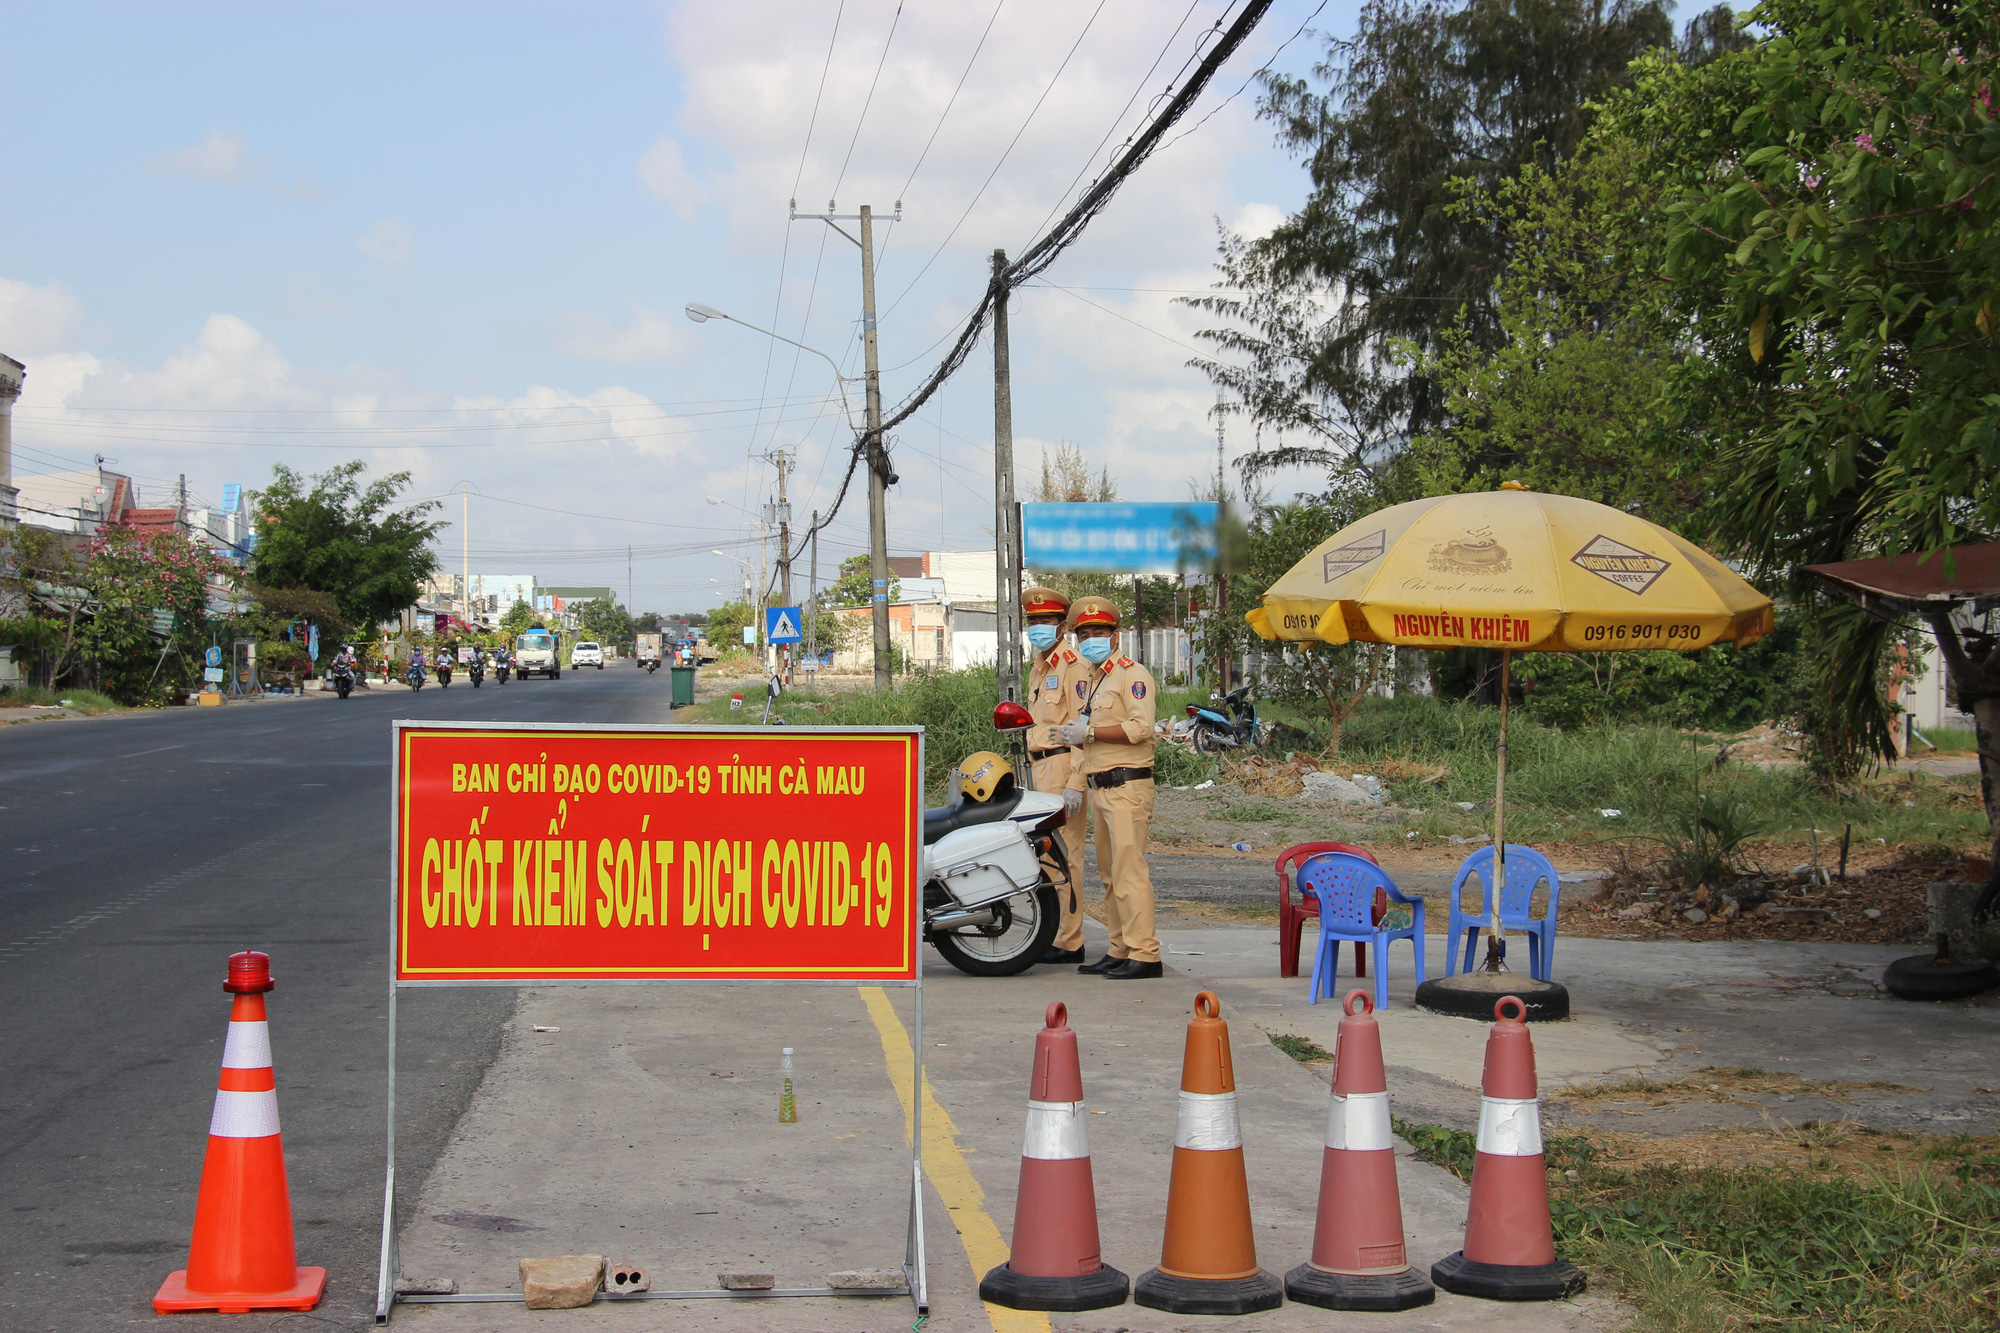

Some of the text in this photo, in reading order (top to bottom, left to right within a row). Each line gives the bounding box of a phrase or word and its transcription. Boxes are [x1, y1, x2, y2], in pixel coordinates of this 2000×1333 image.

[1581, 555, 1661, 572] NGUYÊN KHIÊM
[1612, 574, 1646, 583] COFFEE
[1393, 611, 1530, 643] NGUYÊN KHIÊM
[1584, 624, 1701, 641] 0916 901 030
[452, 752, 866, 802] BAN CHỈ ĐẠO COVID-19 TỈNH CÀ MAU
[421, 798, 893, 951] CHỐT KIỂM SOÁT DỊCH COVID-19
